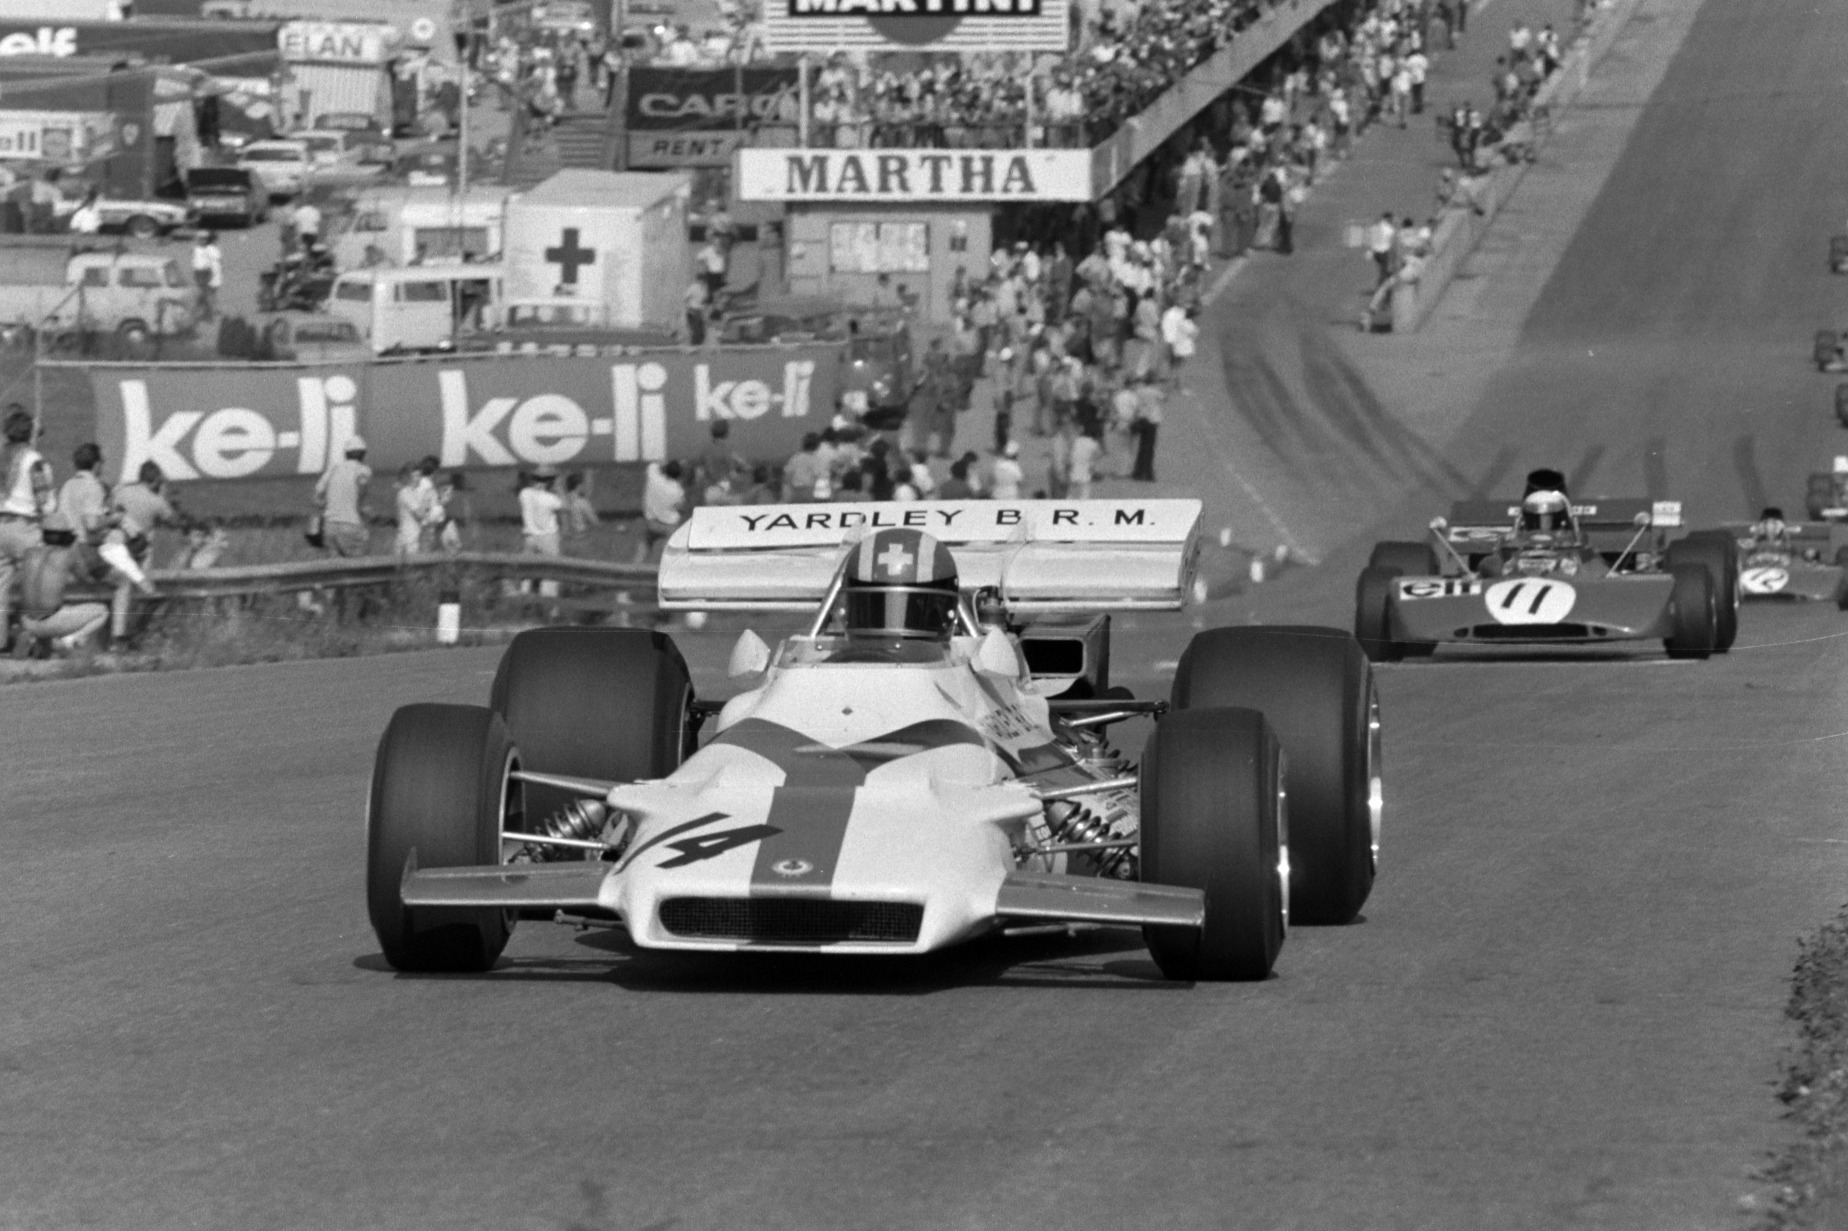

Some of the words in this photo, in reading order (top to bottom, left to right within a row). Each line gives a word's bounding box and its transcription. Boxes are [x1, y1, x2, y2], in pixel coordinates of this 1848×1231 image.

[787, 155, 1036, 193] MARTHA
[438, 362, 667, 466] ke-li
[694, 361, 815, 420] ke-li
[119, 375, 357, 484] ke-li
[739, 509, 964, 531] YARDLEY
[1502, 582, 1552, 614] 11
[612, 812, 784, 876] 14
